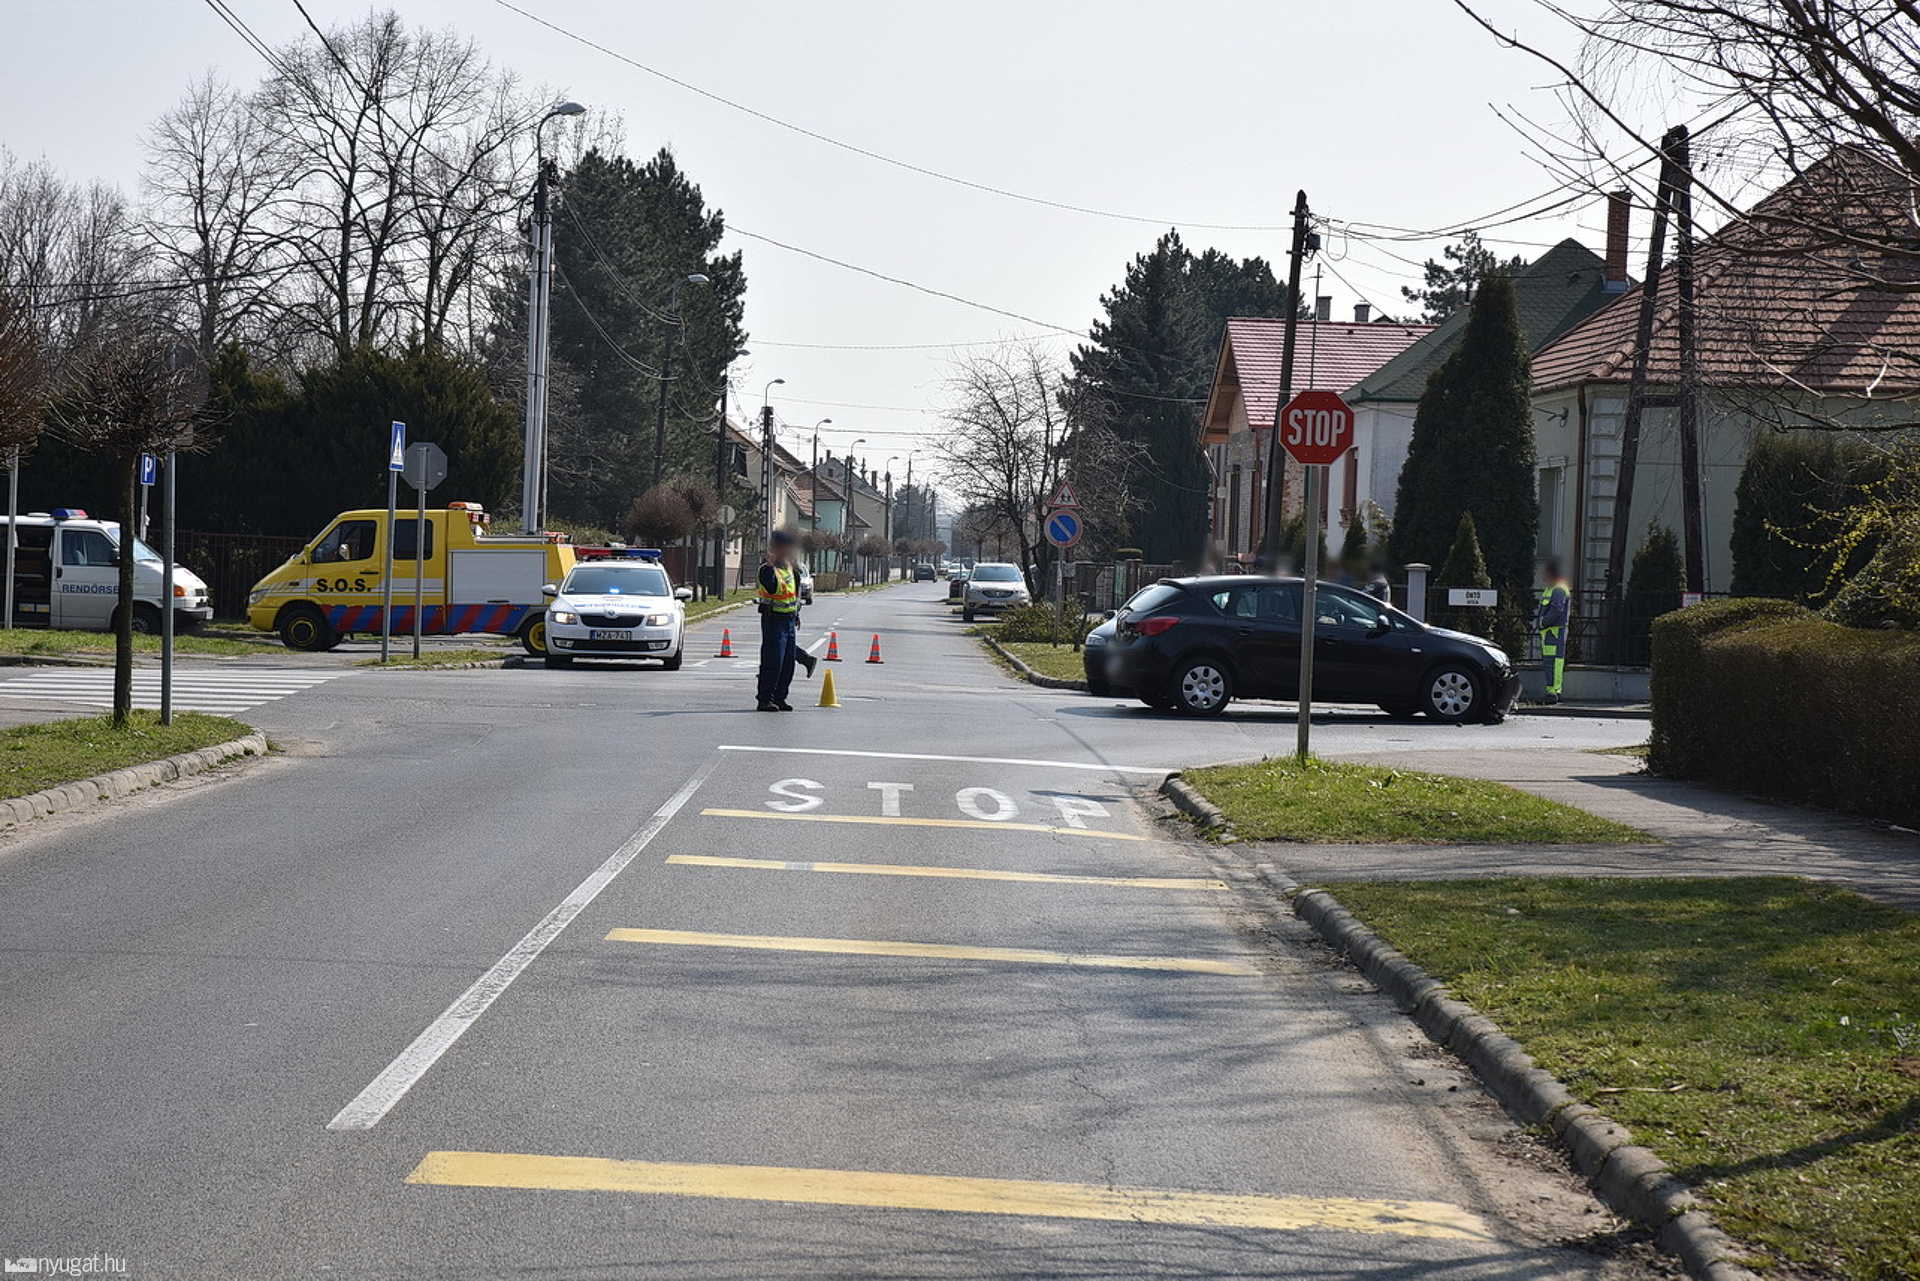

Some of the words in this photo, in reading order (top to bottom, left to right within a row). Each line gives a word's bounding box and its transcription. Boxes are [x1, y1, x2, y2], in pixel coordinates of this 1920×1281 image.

[1288, 408, 1346, 447] STOP
[144, 456, 153, 481] P
[316, 578, 371, 593] S.O.S.
[764, 777, 1111, 829] STOP
